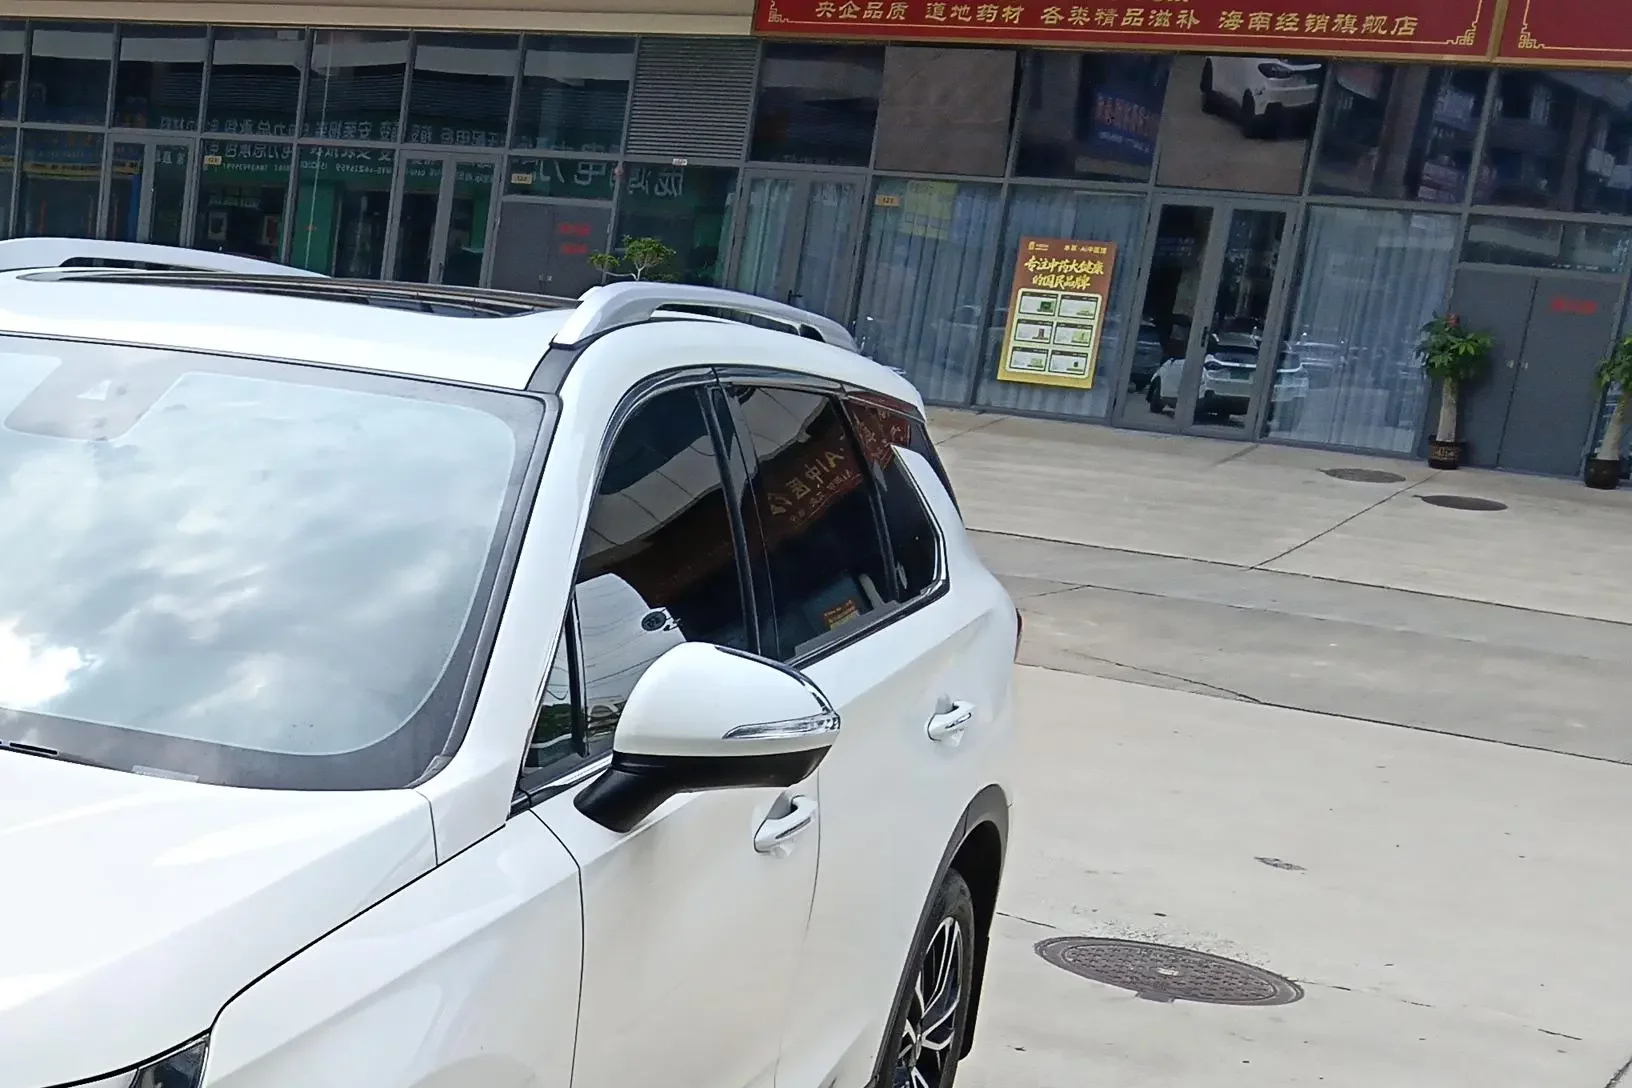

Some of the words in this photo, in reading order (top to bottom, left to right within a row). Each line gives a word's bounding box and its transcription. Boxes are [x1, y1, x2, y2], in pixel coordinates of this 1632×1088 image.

[815, 0, 909, 20] 央企品质
[925, 1, 1024, 25] 道地药材
[1040, 5, 1200, 30] 各类精品滋补
[1218, 9, 1418, 37] 海南经销旗舰店
